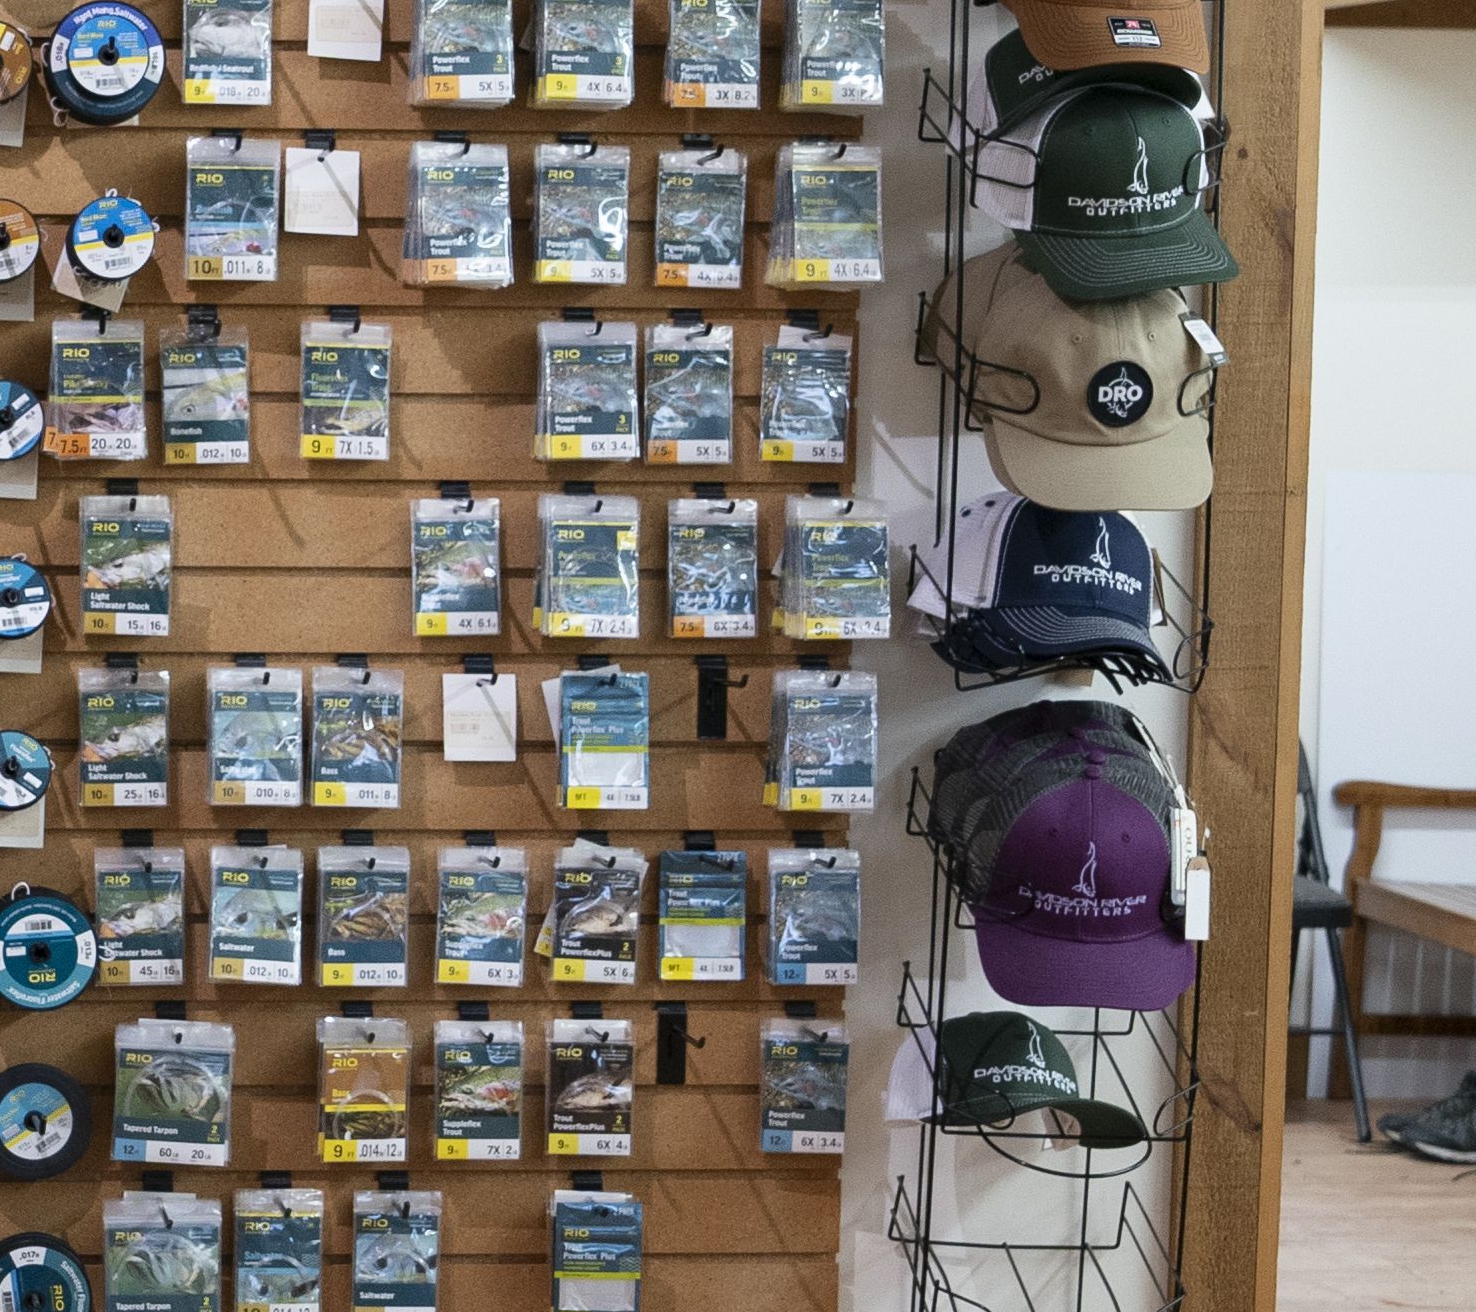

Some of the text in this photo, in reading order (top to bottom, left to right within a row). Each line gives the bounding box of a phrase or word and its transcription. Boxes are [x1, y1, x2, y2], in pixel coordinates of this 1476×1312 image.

[1068, 195, 1148, 209] DAVIDSON
[1086, 198, 1177, 216] OUTFITTERS
[1098, 385, 1143, 403] DRO
[92, 522, 120, 533] RIO
[1034, 564, 1113, 580] DAVIDSON
[1052, 573, 1135, 595] OUTFITTERS
[90, 591, 110, 601] Light
[90, 600, 150, 611] Saltwater Shock
[1101, 894, 1147, 908] RIVER
[1035, 900, 1132, 917] OUTFITTERS
[126, 1053, 153, 1063] RIO
[557, 1047, 583, 1060] RIO
[332, 1058, 358, 1067] RIO
[554, 1115, 574, 1123] Trout
[123, 1124, 179, 1136] Tapered Tarpon
[443, 1127, 463, 1136] Trout
[362, 1218, 388, 1228] RIO
[563, 1252, 597, 1260] Powerflex
[359, 1292, 395, 1300] Saltwater
[116, 1303, 171, 1312] Tapered Tarpon
